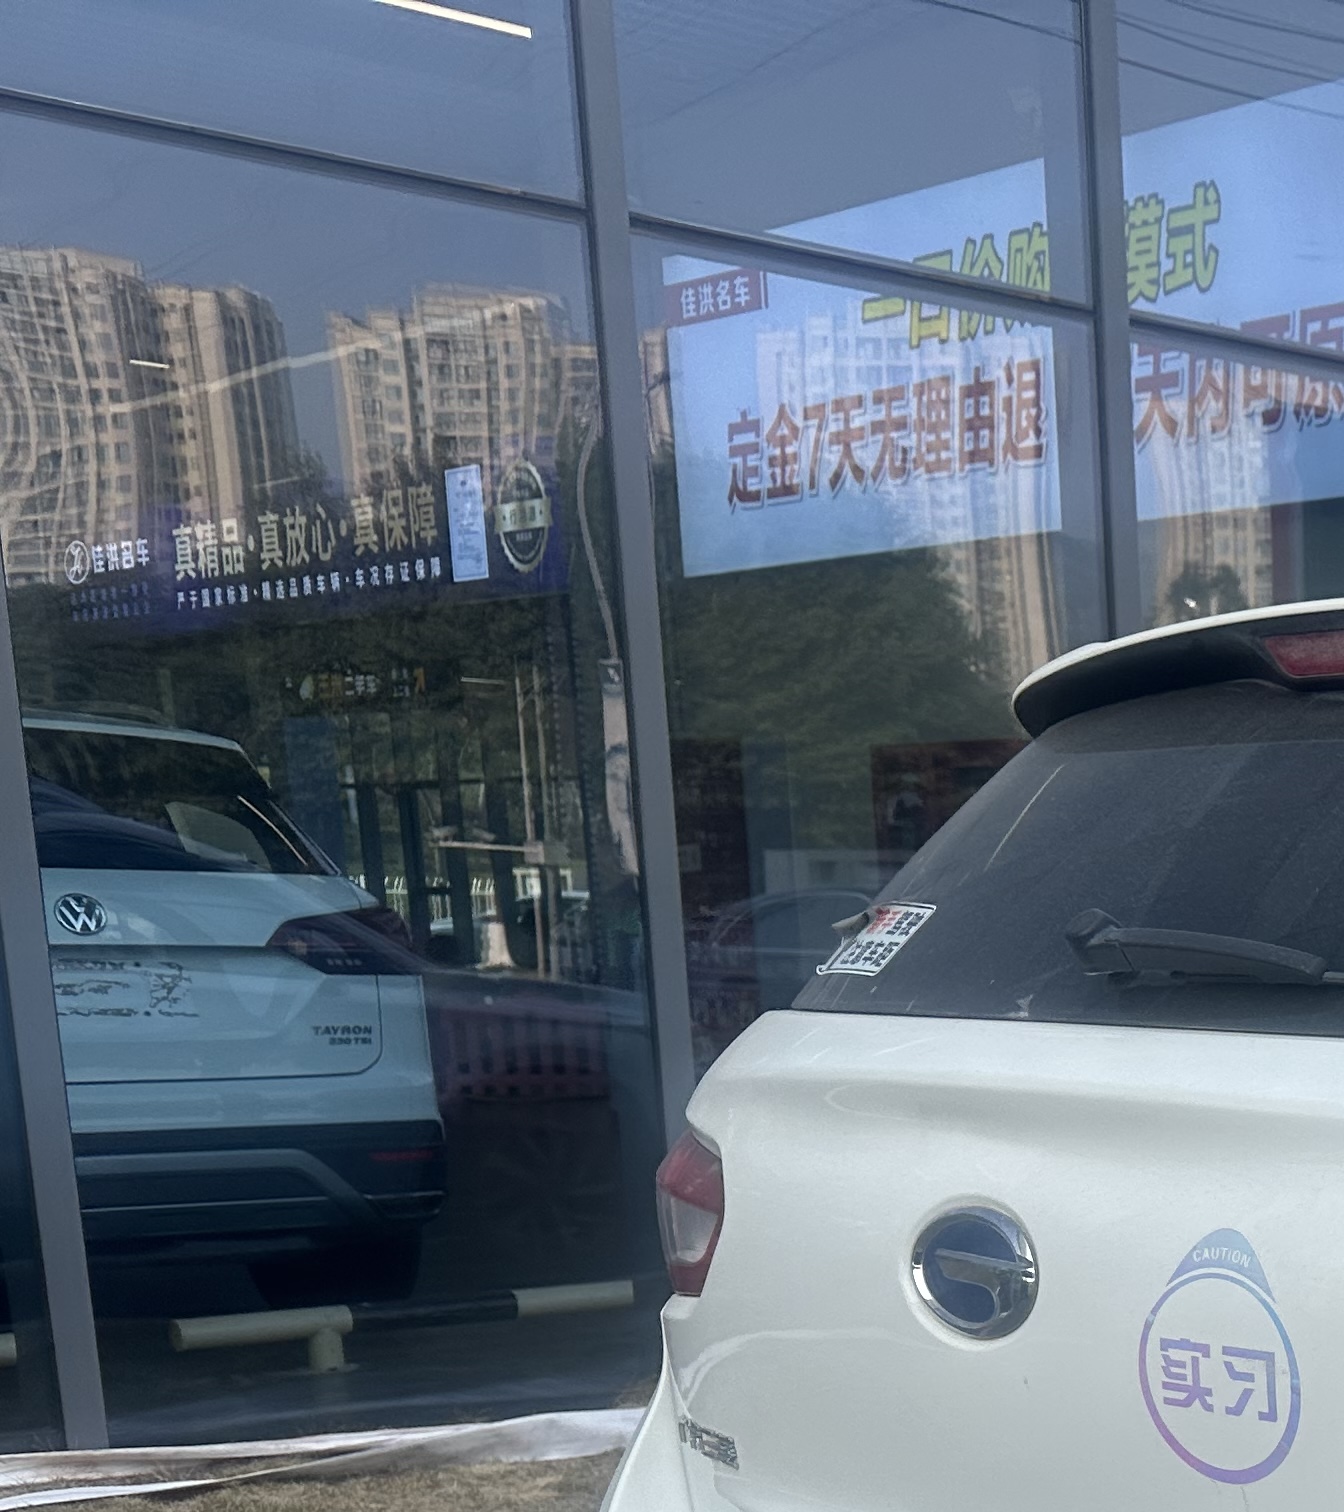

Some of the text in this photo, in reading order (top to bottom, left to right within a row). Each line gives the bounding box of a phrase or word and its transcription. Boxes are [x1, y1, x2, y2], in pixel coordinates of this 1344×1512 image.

[680, 275, 751, 319] 佳洪名车
[91, 537, 150, 575] 佳洪名车
[312, 1025, 373, 1036] TAYRON
[1191, 1247, 1252, 1269] CAUTION
[1159, 1337, 1278, 1423] 实习
